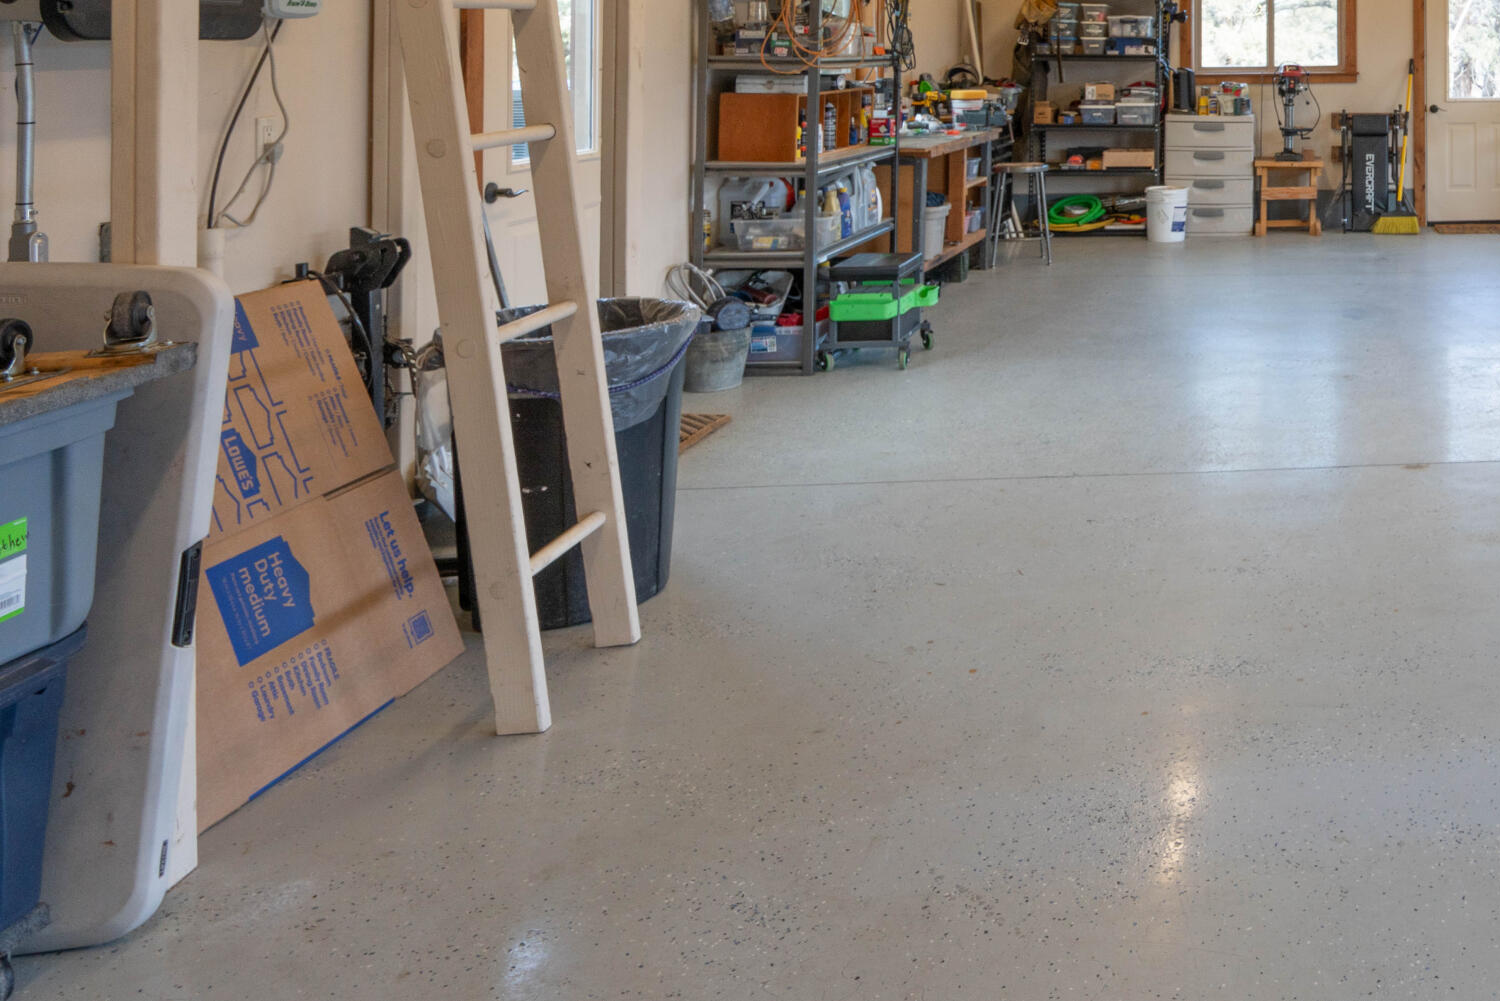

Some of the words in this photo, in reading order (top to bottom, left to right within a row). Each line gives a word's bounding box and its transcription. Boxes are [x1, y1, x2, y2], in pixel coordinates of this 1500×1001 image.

[1365, 153, 1375, 214] EVERCRAFT
[224, 435, 254, 491] LOWE'S
[379, 510, 395, 538] Let
[389, 539, 402, 558] us
[398, 558, 415, 599] help.
[254, 558, 278, 600] Duty
[267, 552, 297, 607] Heavy
[238, 567, 272, 637] medium
[316, 651, 331, 687] Bedroom
[324, 646, 340, 680] FRAGILE
[251, 690, 266, 722] Garage
[260, 684, 275, 720] Laundry
[277, 674, 295, 716] Basement
